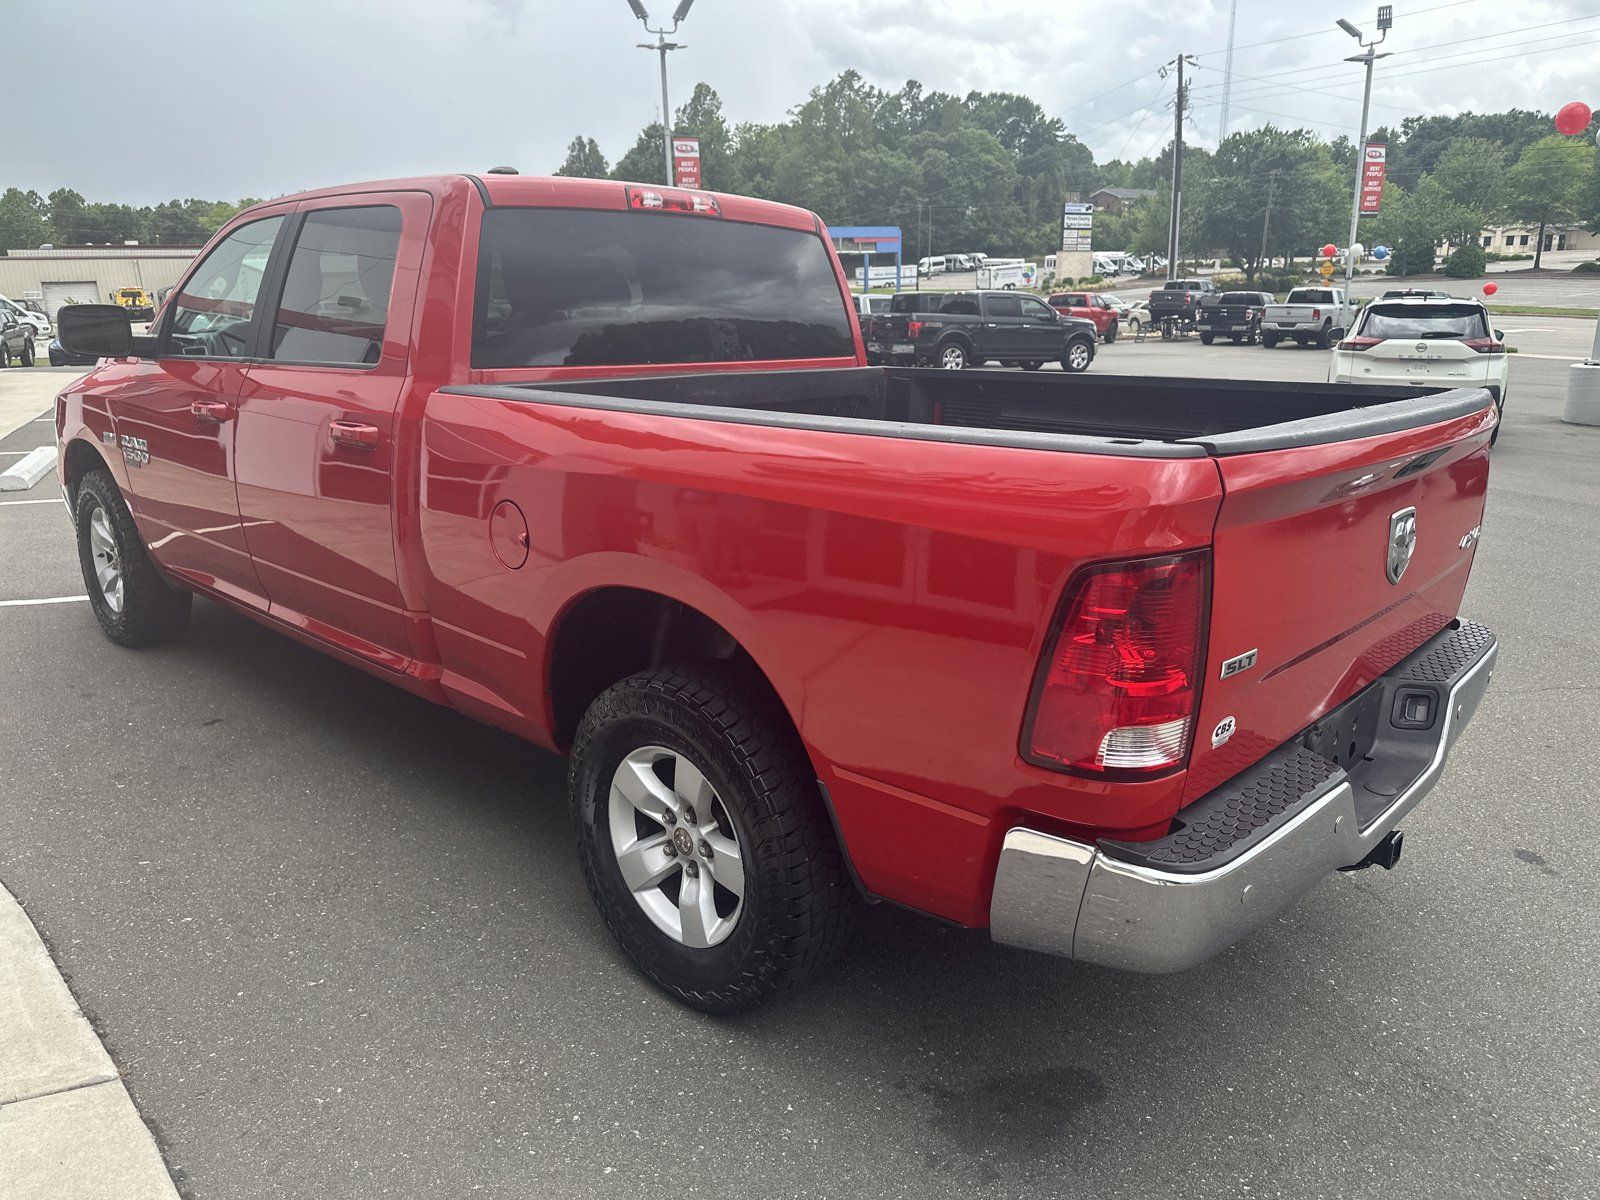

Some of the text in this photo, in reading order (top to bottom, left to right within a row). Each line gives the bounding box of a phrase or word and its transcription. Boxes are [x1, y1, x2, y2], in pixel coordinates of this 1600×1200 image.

[121, 434, 148, 451] RAM
[1225, 653, 1256, 676] SLT
[1214, 719, 1233, 738] CBS
